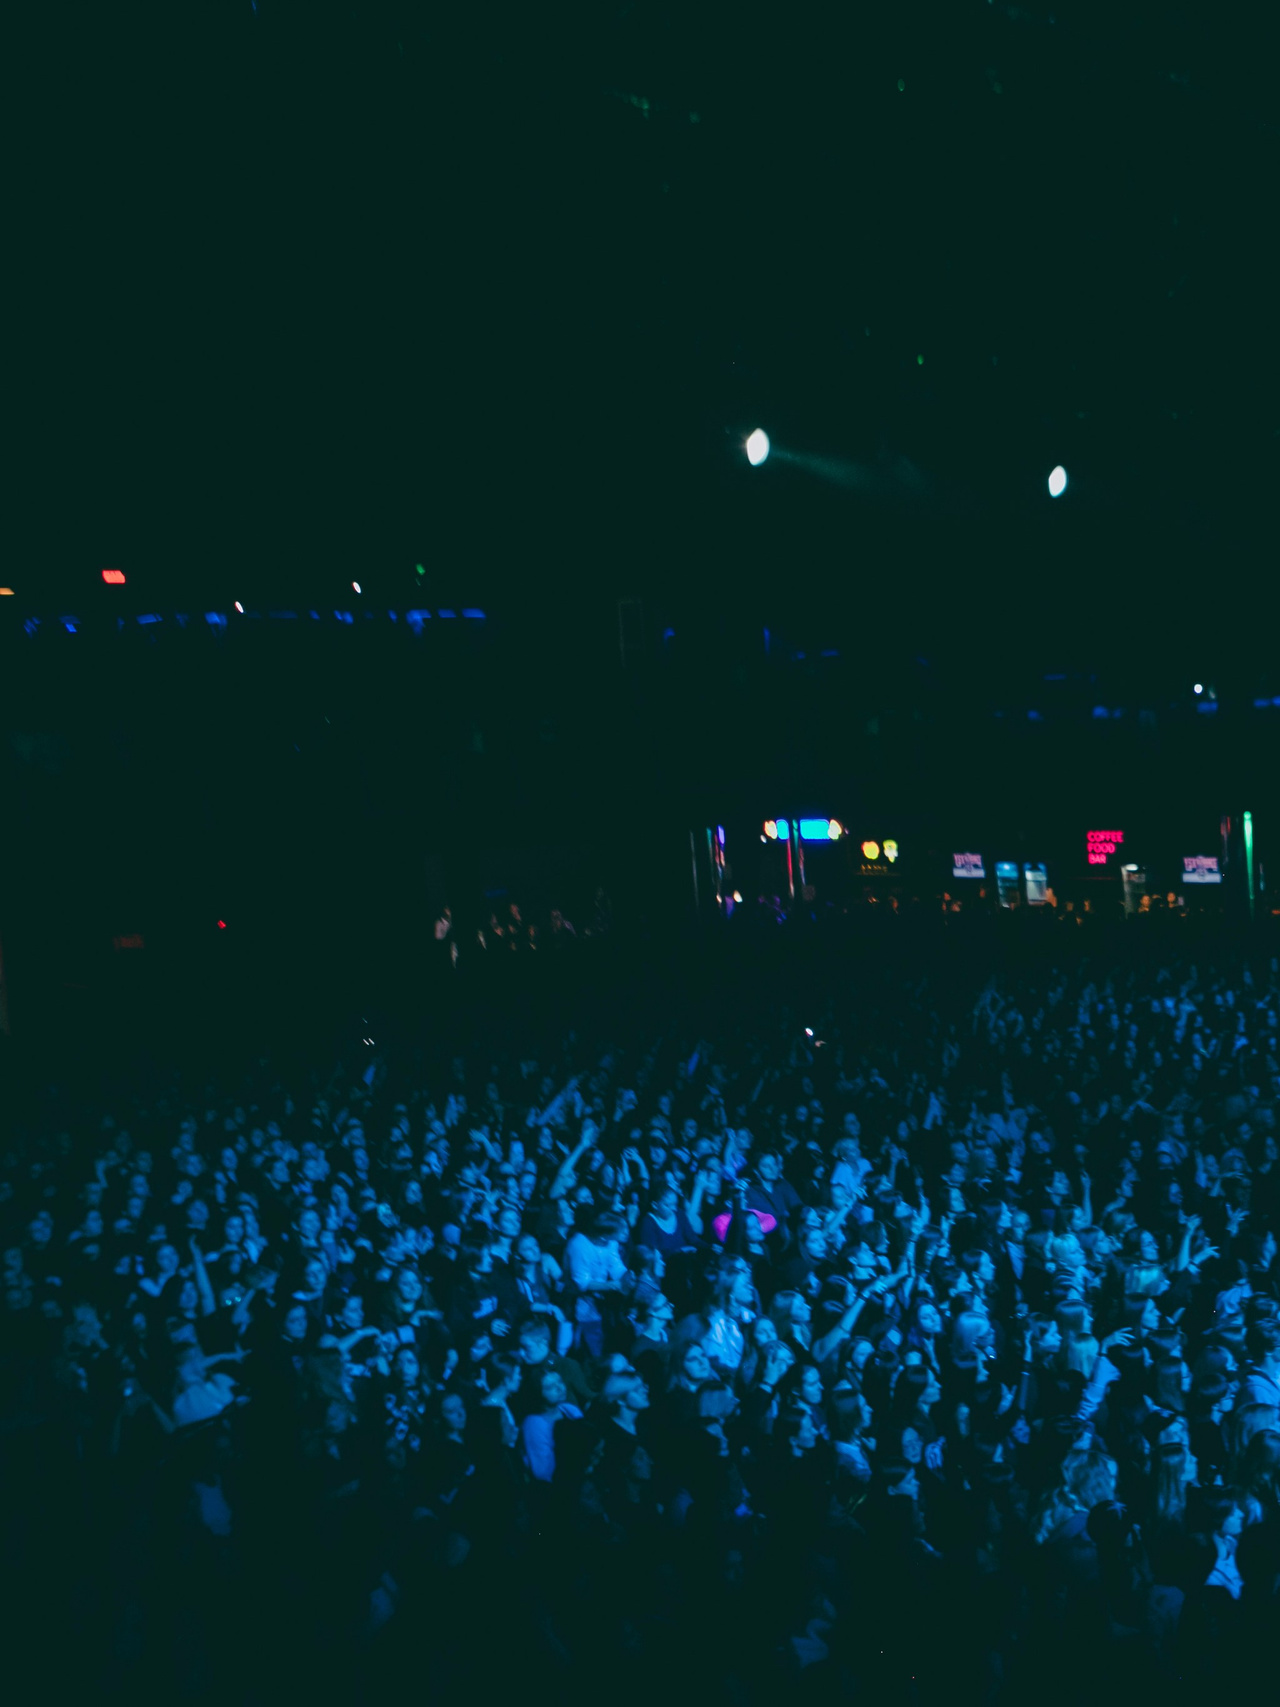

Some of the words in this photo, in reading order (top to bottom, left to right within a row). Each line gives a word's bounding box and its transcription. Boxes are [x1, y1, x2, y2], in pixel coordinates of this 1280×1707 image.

[1087, 830, 1124, 843] COFFEE
[1087, 842, 1116, 854] FOOD
[1088, 853, 1107, 864] BAR
